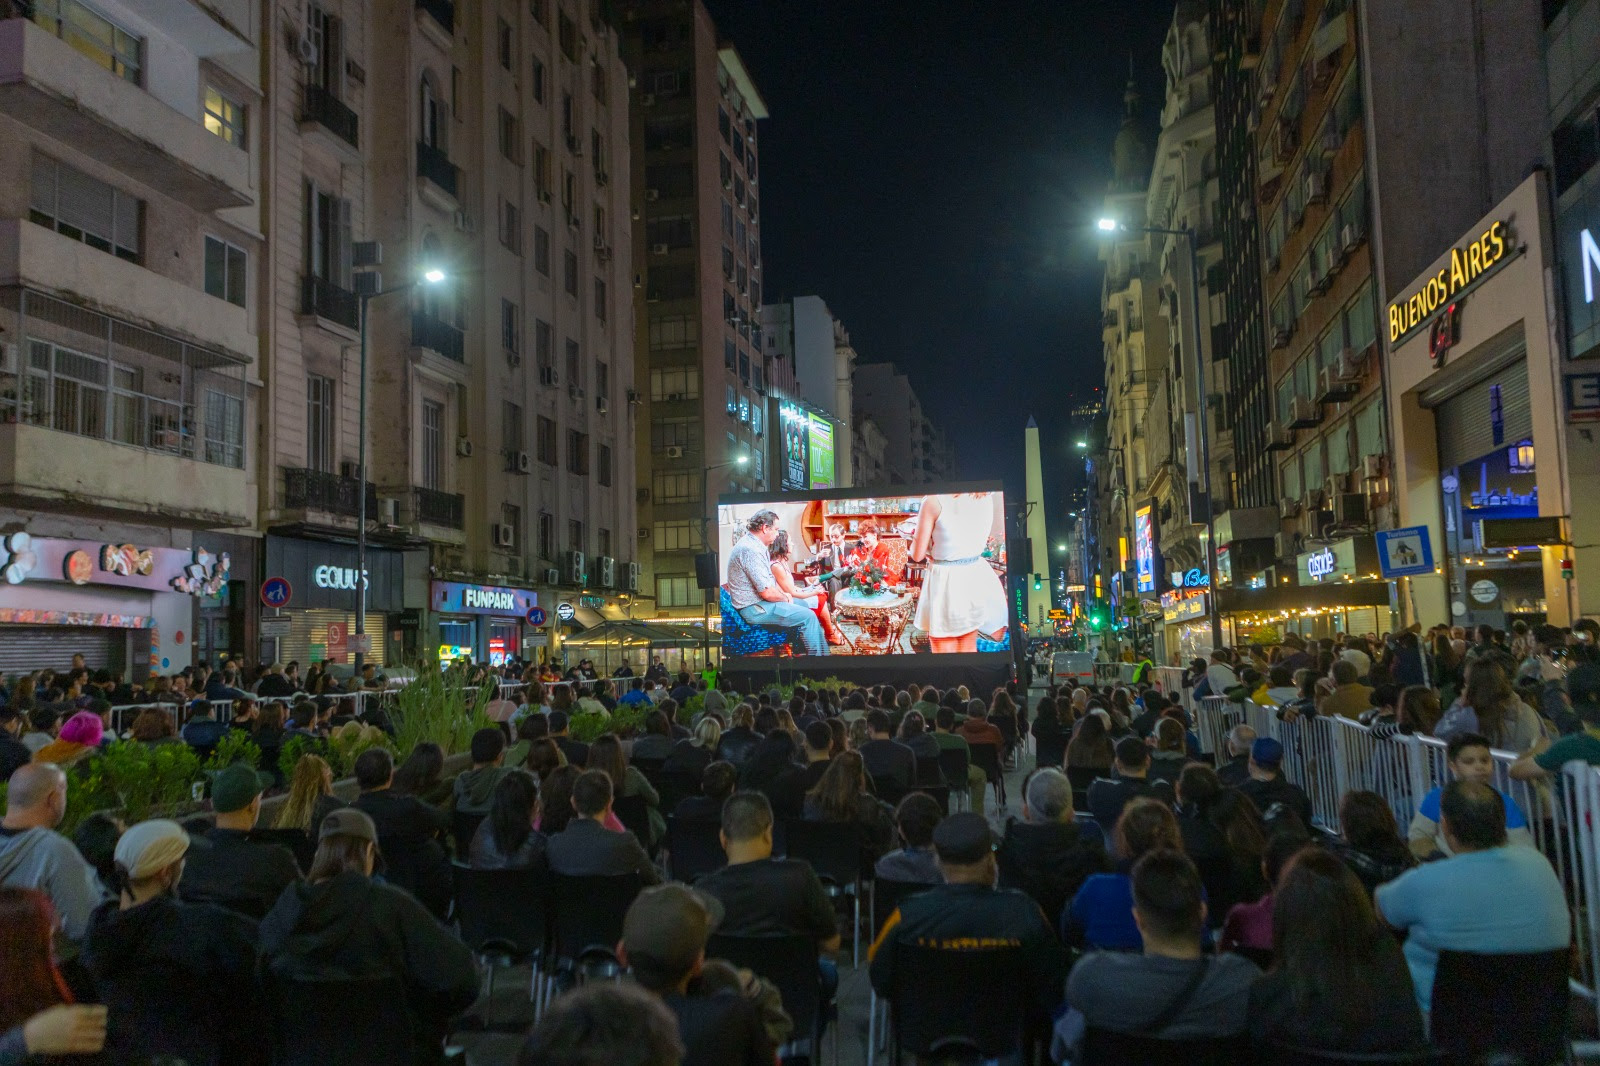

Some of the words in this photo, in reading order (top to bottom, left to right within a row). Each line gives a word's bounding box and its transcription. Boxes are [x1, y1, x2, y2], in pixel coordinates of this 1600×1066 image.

[1389, 268, 1448, 343] BUENOS
[1448, 221, 1505, 295] AIRES
[1386, 529, 1419, 539] Turismo
[465, 589, 515, 610] FUNPARK
